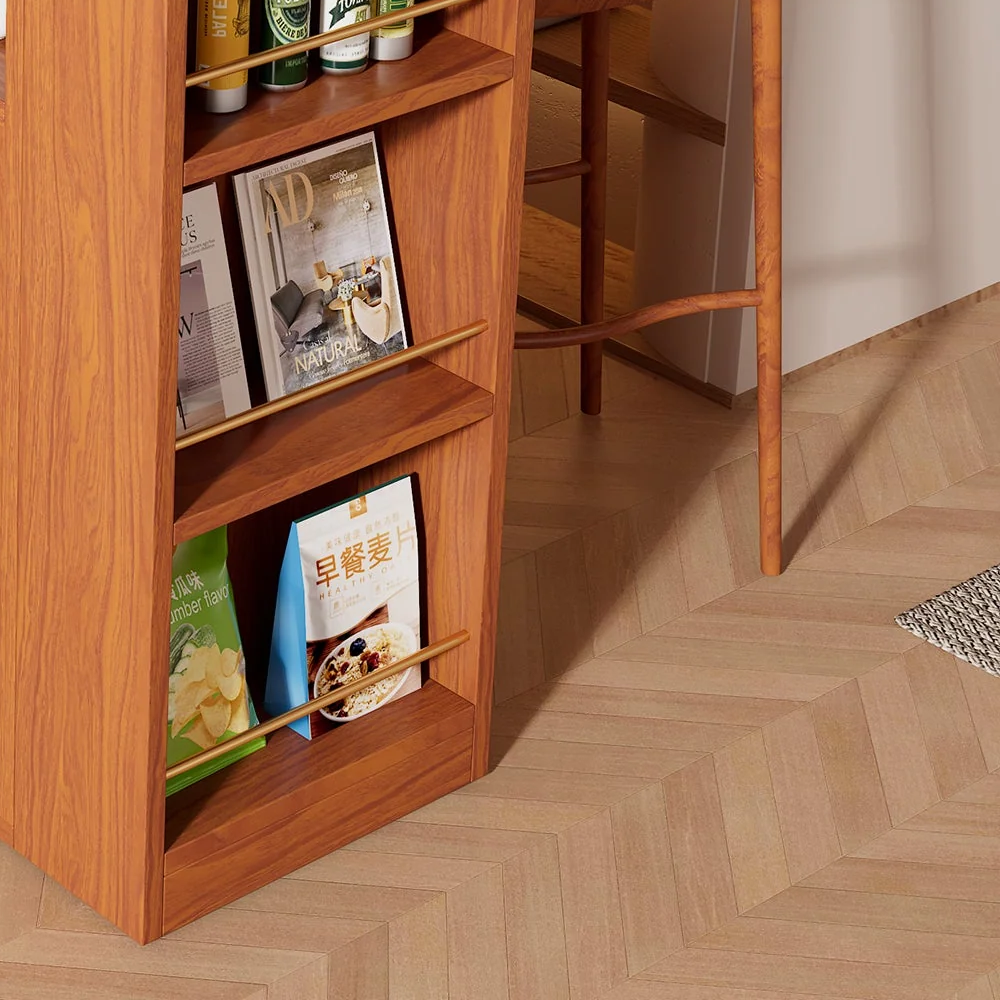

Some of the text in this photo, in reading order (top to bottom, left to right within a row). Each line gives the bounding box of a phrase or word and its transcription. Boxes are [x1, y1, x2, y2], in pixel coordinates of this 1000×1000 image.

[263, 170, 314, 236] AD
[294, 336, 362, 375] NATURAL
[315, 521, 416, 588] 早餐麦片
[318, 571, 375, 600] HEALTHY
